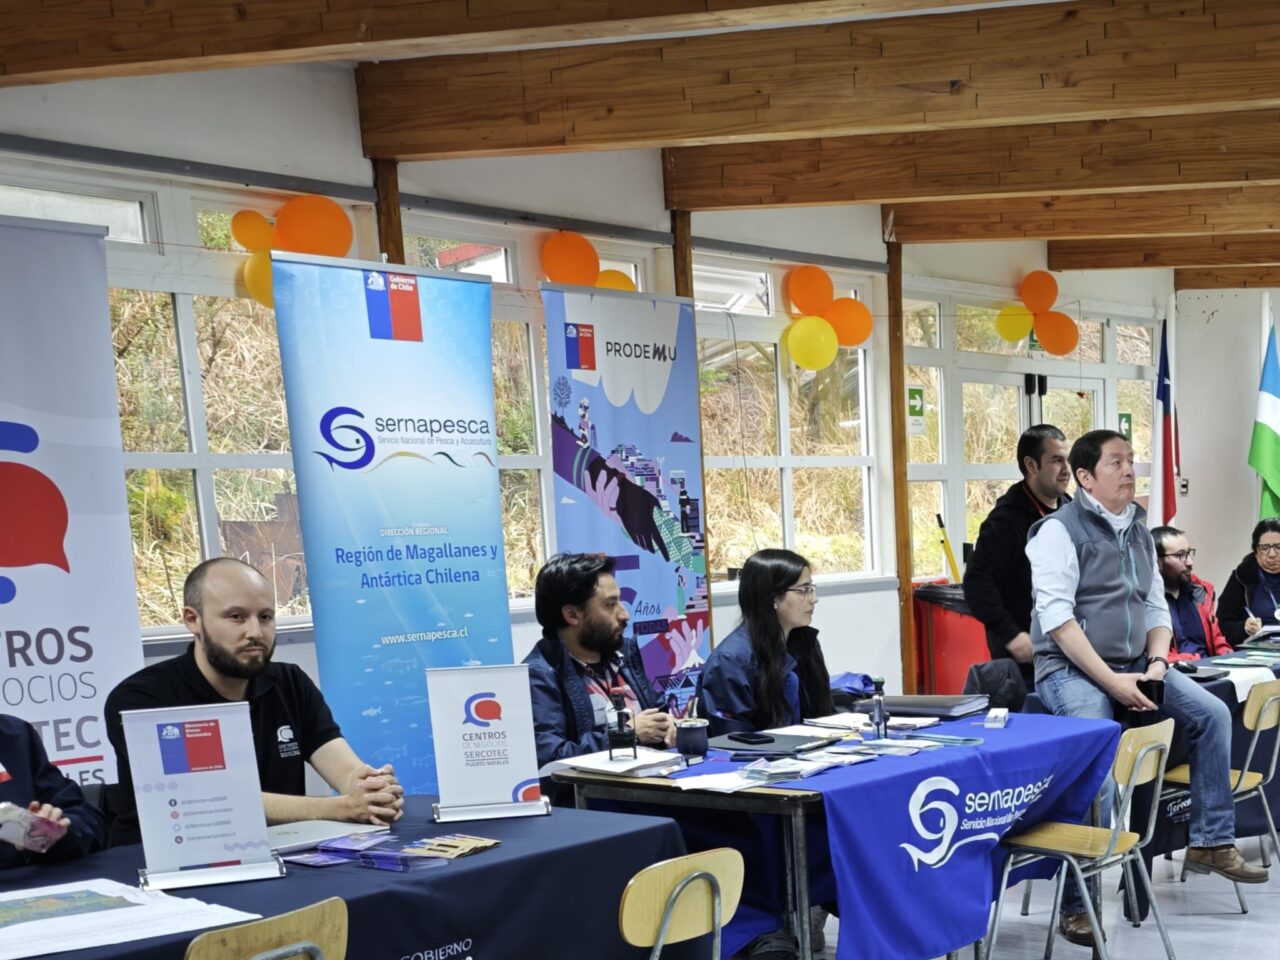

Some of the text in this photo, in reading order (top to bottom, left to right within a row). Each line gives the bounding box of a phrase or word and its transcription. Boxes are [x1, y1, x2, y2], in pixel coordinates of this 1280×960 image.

[605, 341, 677, 362] PRODEMU
[375, 417, 490, 437] sernapesca
[378, 436, 399, 445] Servicio
[401, 436, 425, 445] Nacional
[427, 436, 434, 445] de
[436, 437, 454, 446] Pesca
[380, 527, 448, 537] DIRECCIÓN REGIONAL
[335, 542, 498, 567] Región de Magallanes y
[361, 568, 480, 589] Antártica Chilena
[634, 600, 661, 616] Años
[381, 626, 469, 645] www.sernapesca.cl
[0, 625, 94, 668] ROS
[462, 731, 507, 741] CENTROS
[464, 748, 509, 759] SERCOTEC
[960, 817, 986, 830] Servicio
